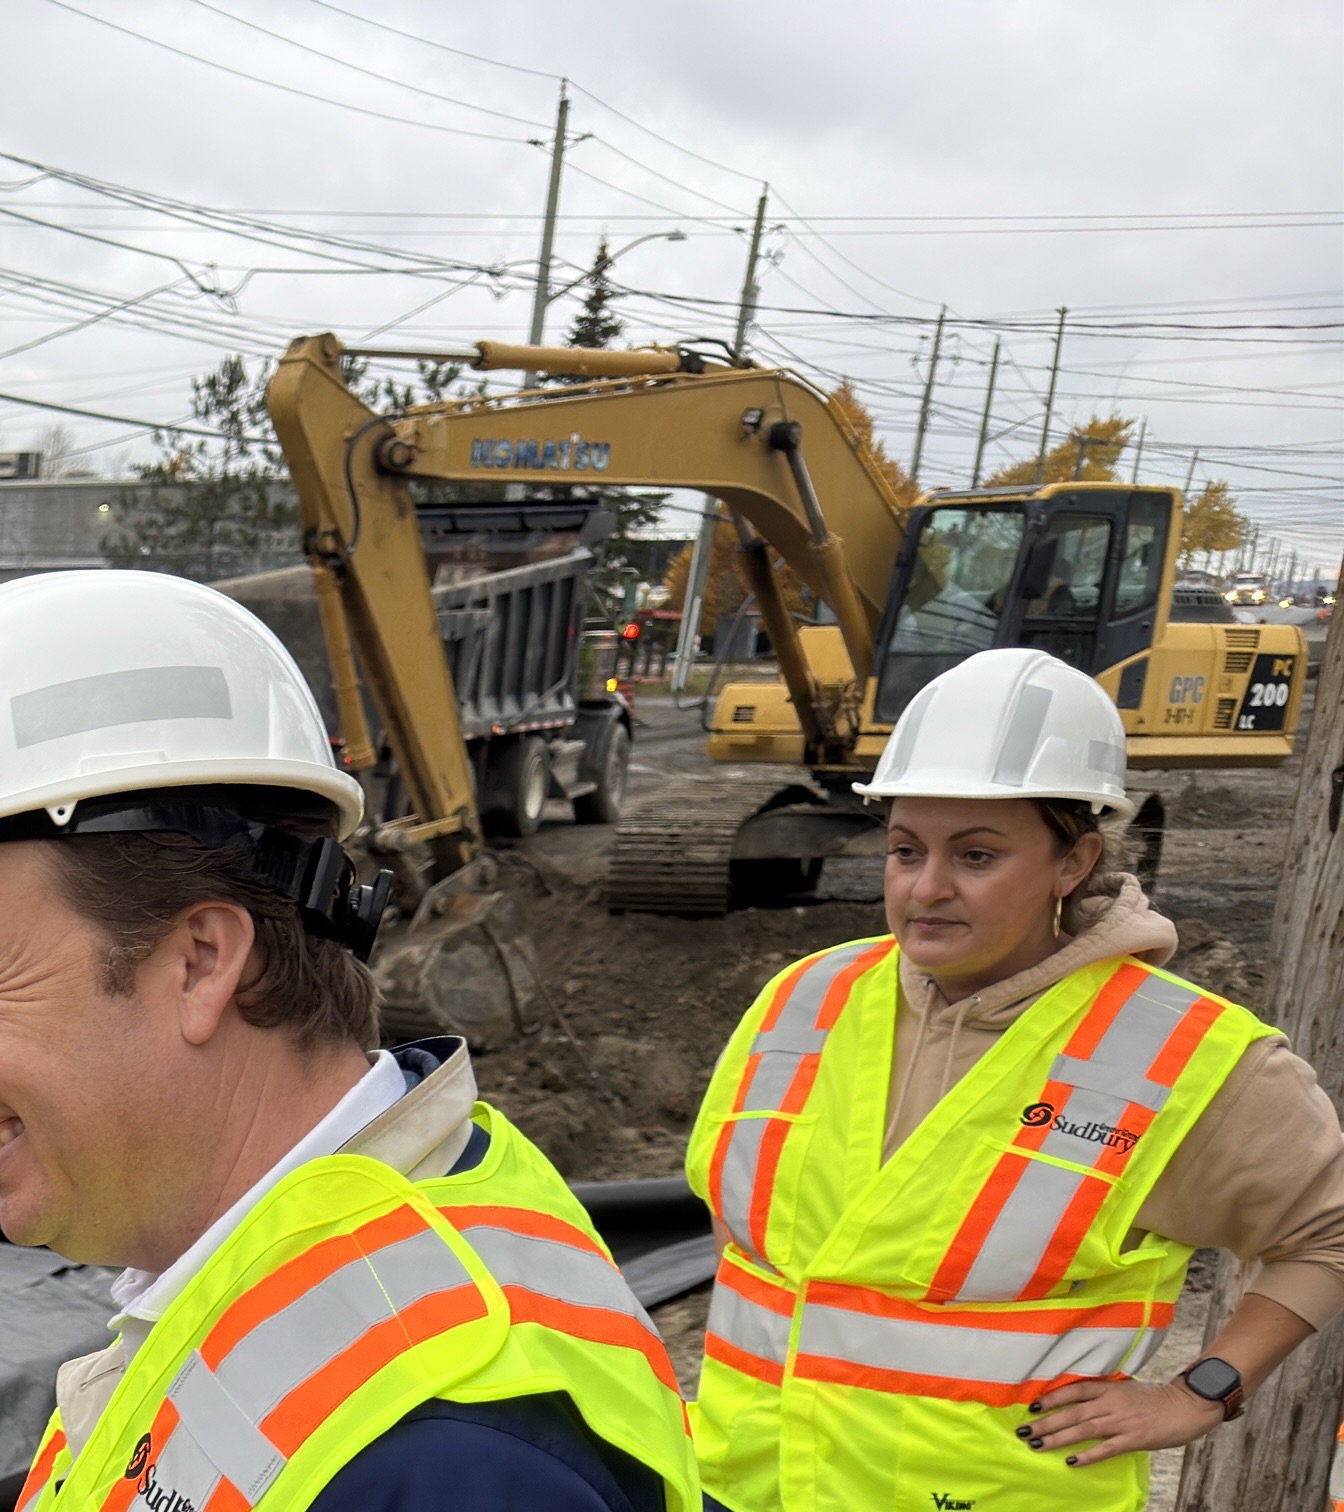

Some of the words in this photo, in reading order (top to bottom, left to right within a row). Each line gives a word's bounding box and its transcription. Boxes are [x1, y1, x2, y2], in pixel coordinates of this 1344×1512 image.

[470, 437, 611, 472] KOMATSU
[1272, 658, 1293, 677] PC
[1168, 675, 1205, 705] GPC
[1249, 682, 1289, 707] 200
[1238, 714, 1256, 730] LC
[1050, 1115, 1137, 1155] Sudbury
